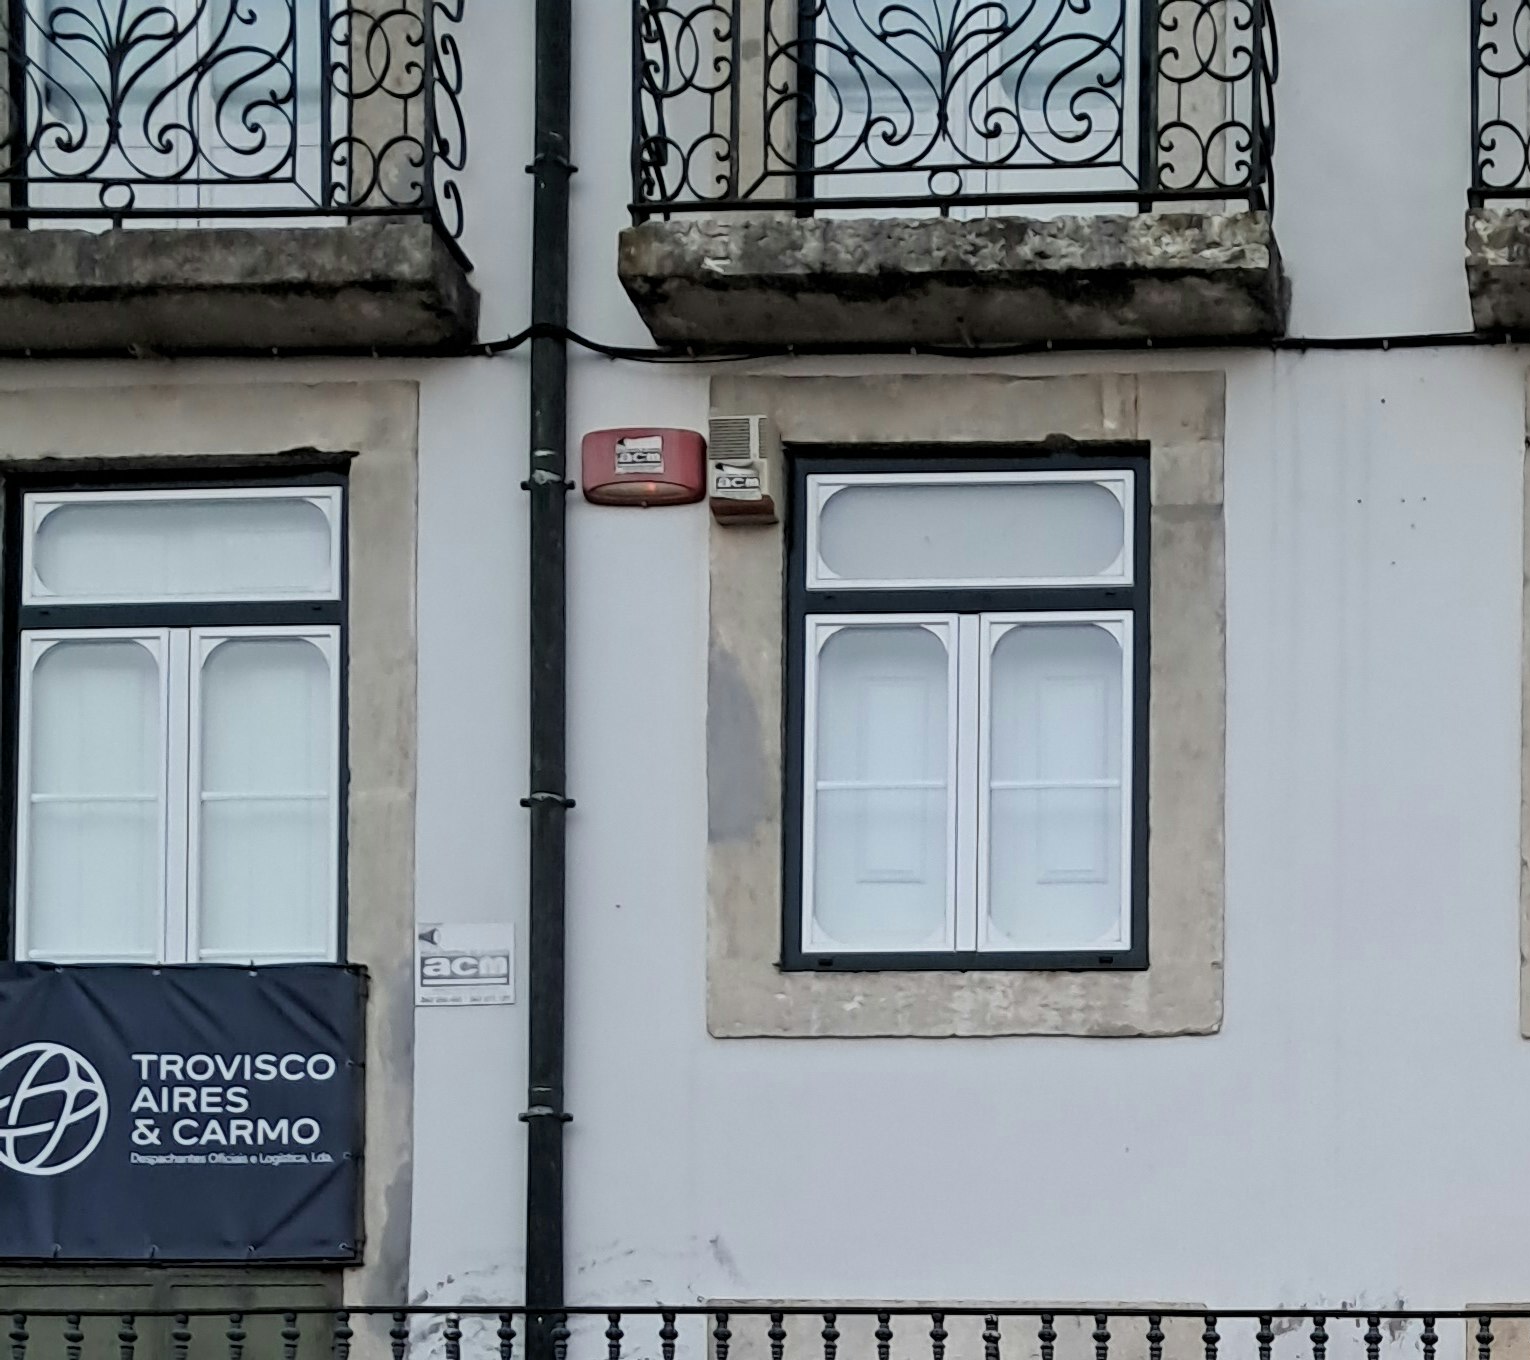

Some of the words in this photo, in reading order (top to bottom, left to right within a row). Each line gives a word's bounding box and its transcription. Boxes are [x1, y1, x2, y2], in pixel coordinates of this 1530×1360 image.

[619, 452, 661, 463] acm
[717, 477, 760, 488] acm
[422, 956, 508, 977] acm
[131, 1054, 337, 1081] TROVISCO
[130, 1086, 250, 1113] AIRES
[131, 1118, 162, 1146] &
[172, 1118, 321, 1146] CARMO
